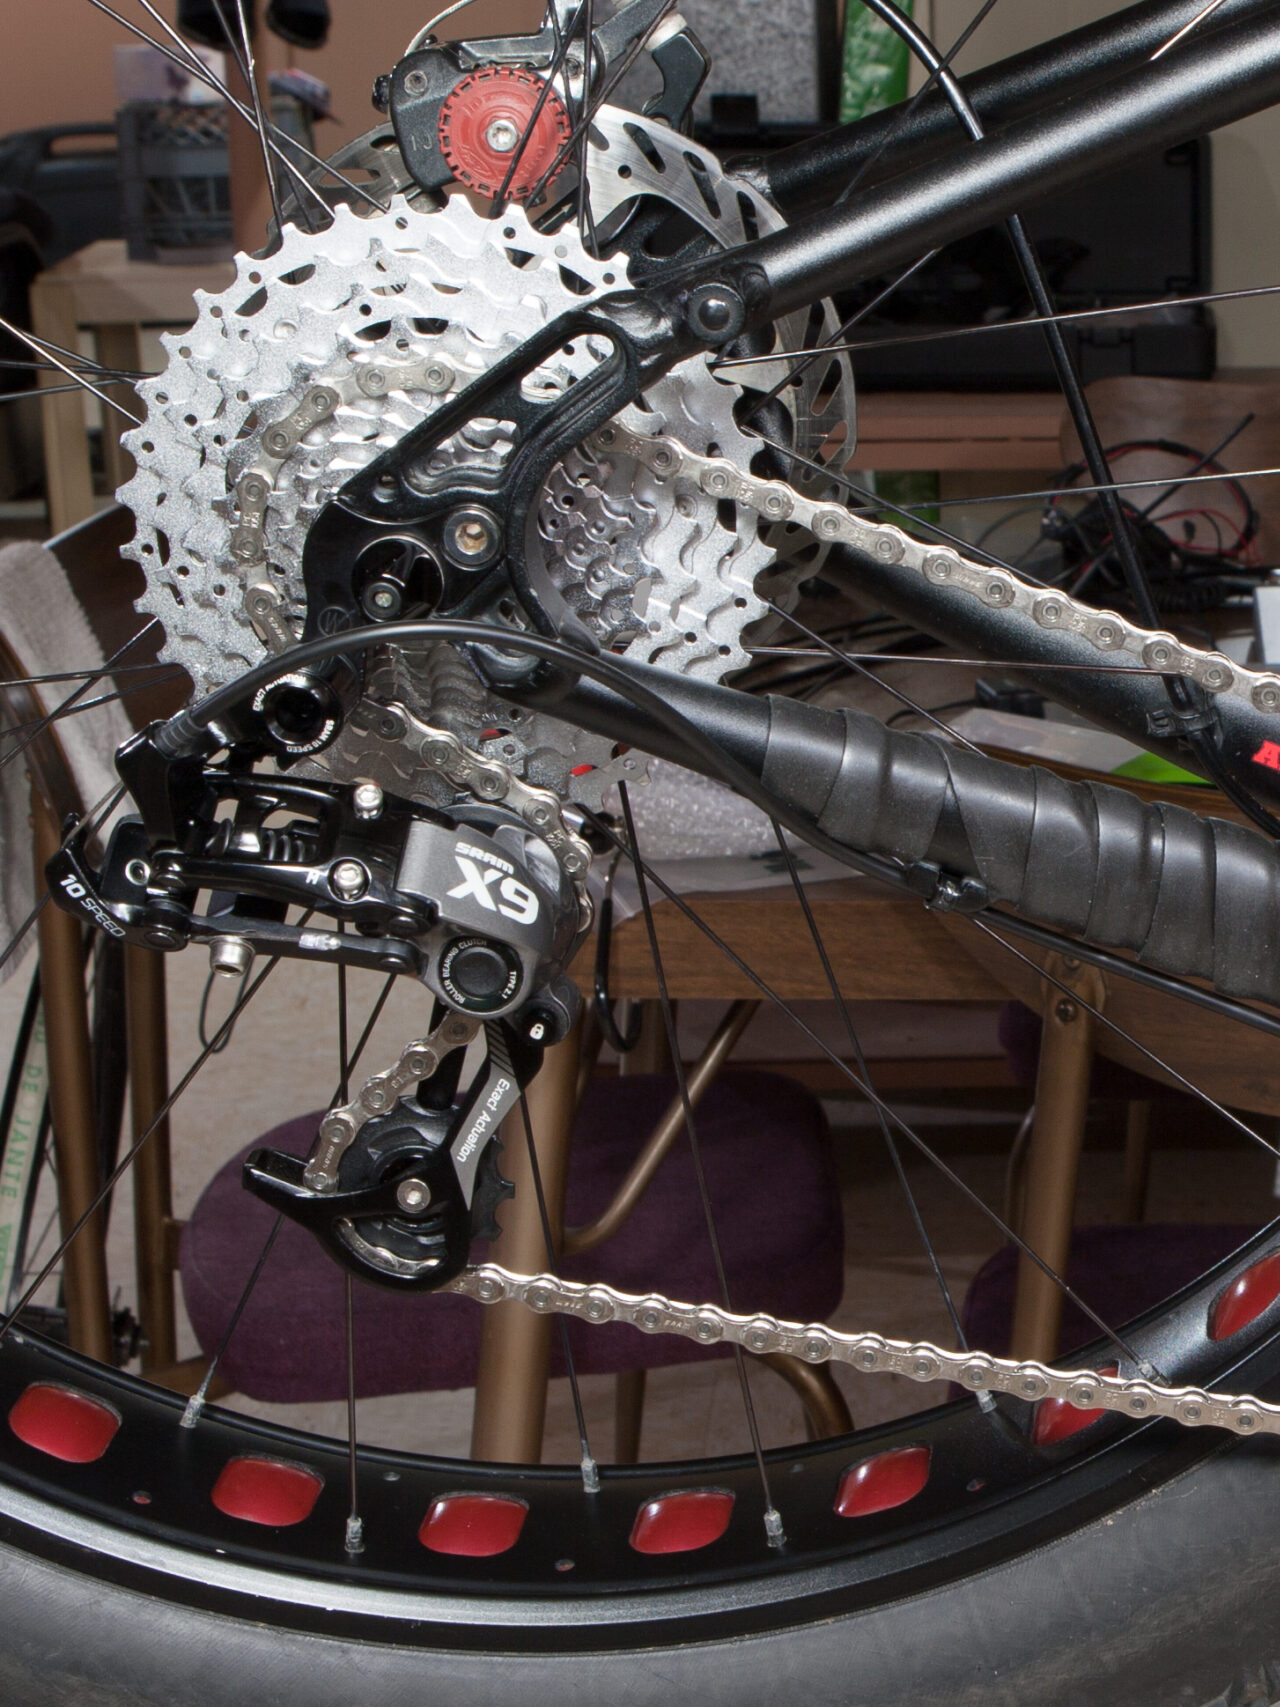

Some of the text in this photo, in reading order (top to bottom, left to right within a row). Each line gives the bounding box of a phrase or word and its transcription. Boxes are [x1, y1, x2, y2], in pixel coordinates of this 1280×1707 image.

[446, 855, 539, 924] X9
[455, 841, 514, 875] SRAM
[60, 873, 126, 937] 10 SPEED
[442, 948, 459, 978] BEARING
[458, 938, 488, 950] CLUTCH
[21, 1061, 44, 1093] DE
[456, 1078, 510, 1163] Exact Actuation
[0, 1113, 32, 1200] JANTE
